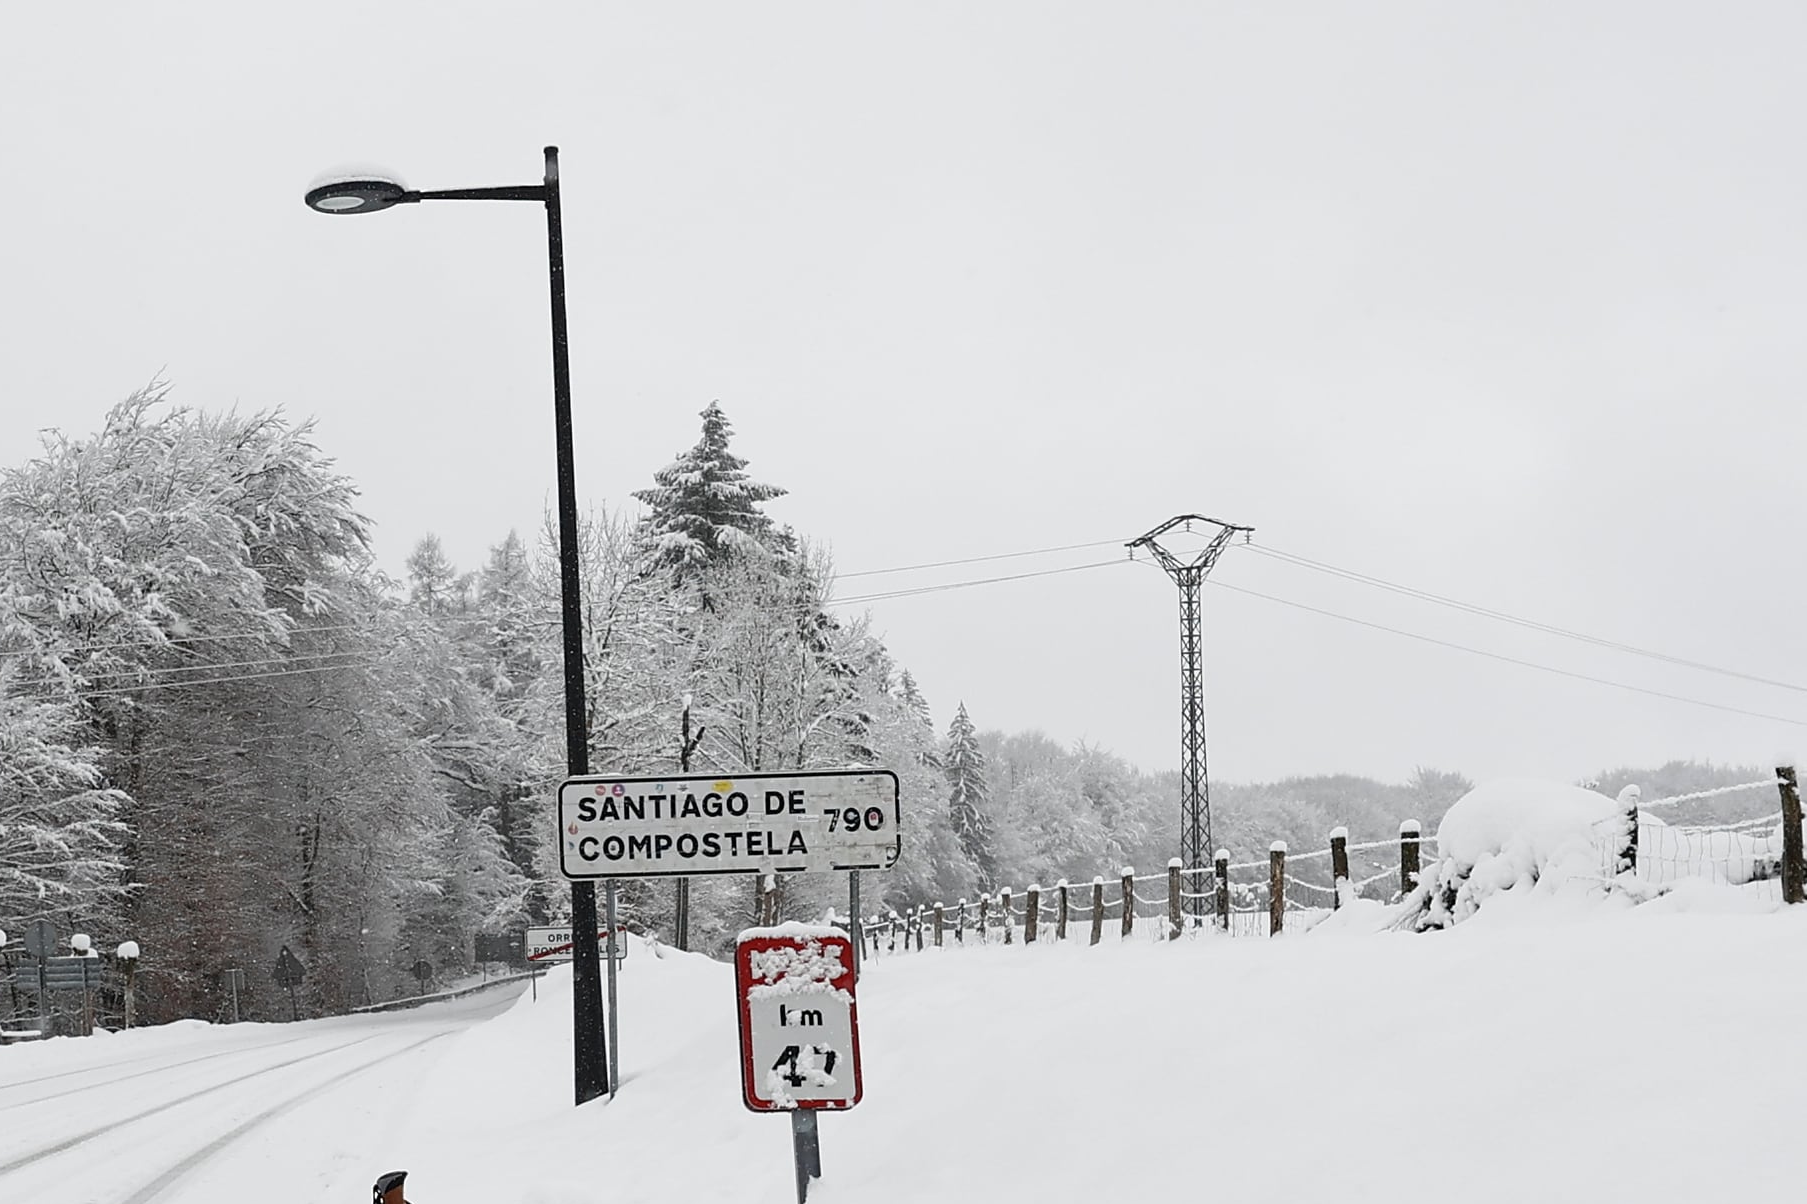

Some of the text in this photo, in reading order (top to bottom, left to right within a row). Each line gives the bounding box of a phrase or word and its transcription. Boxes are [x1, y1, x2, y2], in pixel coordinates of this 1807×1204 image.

[577, 790, 806, 822] SANTIAGO DE
[823, 807, 884, 832] 790
[579, 830, 808, 861] COMPOSTELA
